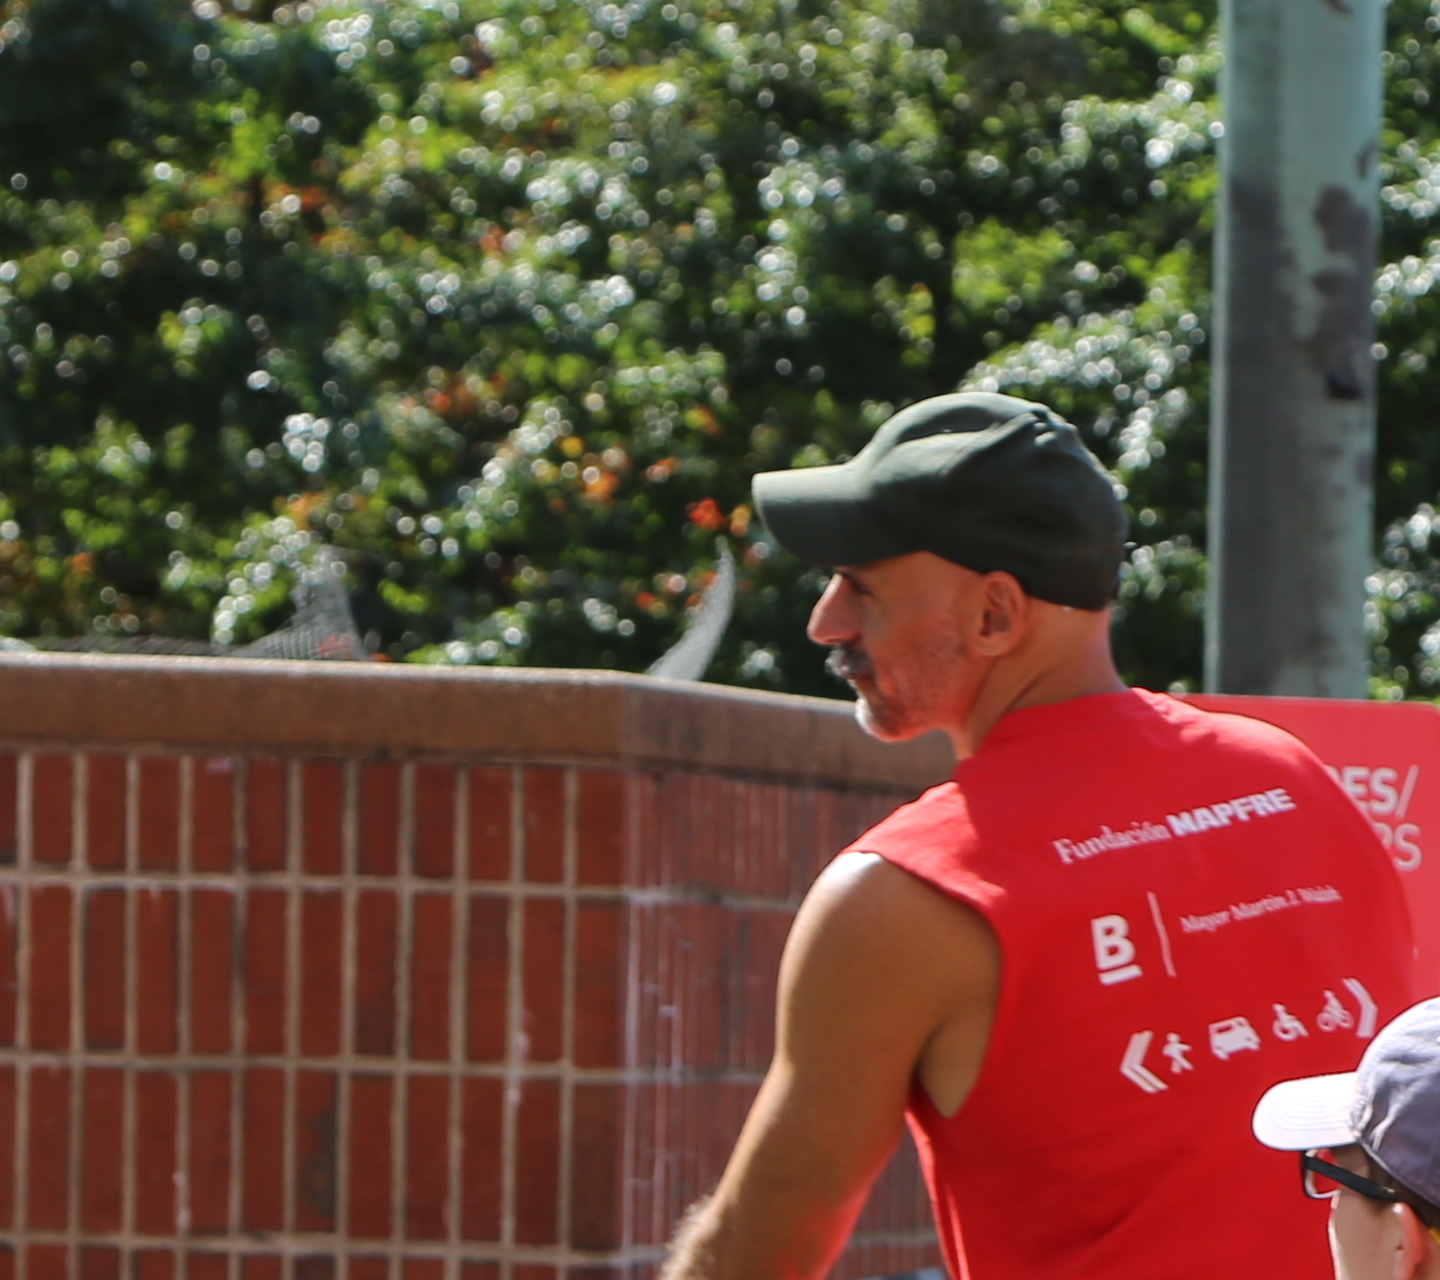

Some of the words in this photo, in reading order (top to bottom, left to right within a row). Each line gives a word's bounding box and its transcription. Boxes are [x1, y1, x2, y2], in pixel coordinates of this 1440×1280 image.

[1166, 787, 1297, 837] MAPFRE
[1324, 763, 1420, 820] ES/
[1091, 914, 1137, 970] B
